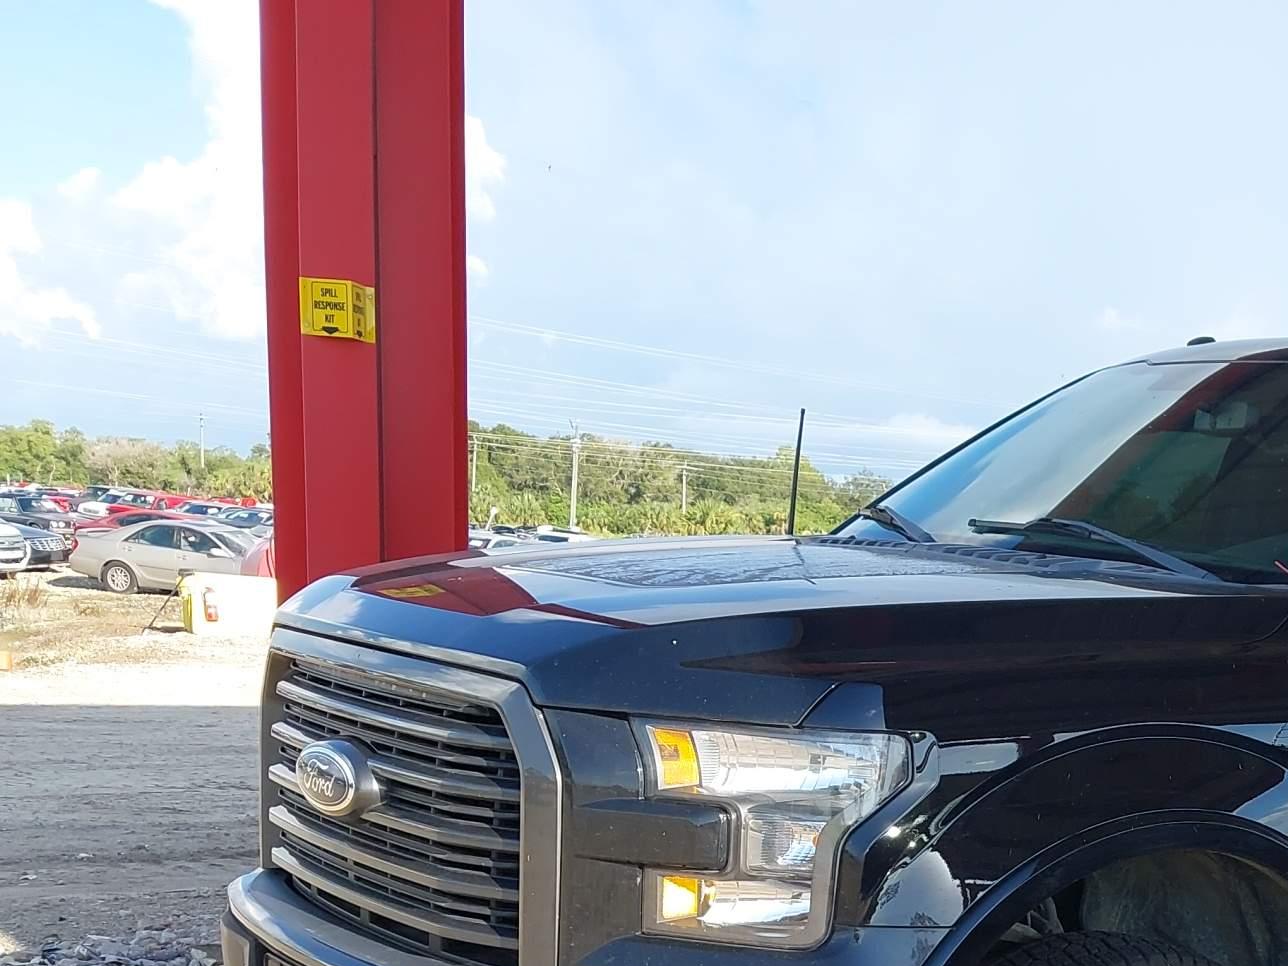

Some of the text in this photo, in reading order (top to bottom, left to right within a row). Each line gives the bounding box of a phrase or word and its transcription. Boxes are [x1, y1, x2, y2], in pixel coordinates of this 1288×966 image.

[320, 287, 338, 298] SPILL
[313, 300, 346, 312] RESPONSE
[324, 314, 335, 324] KIT
[303, 758, 336, 798] Ford
